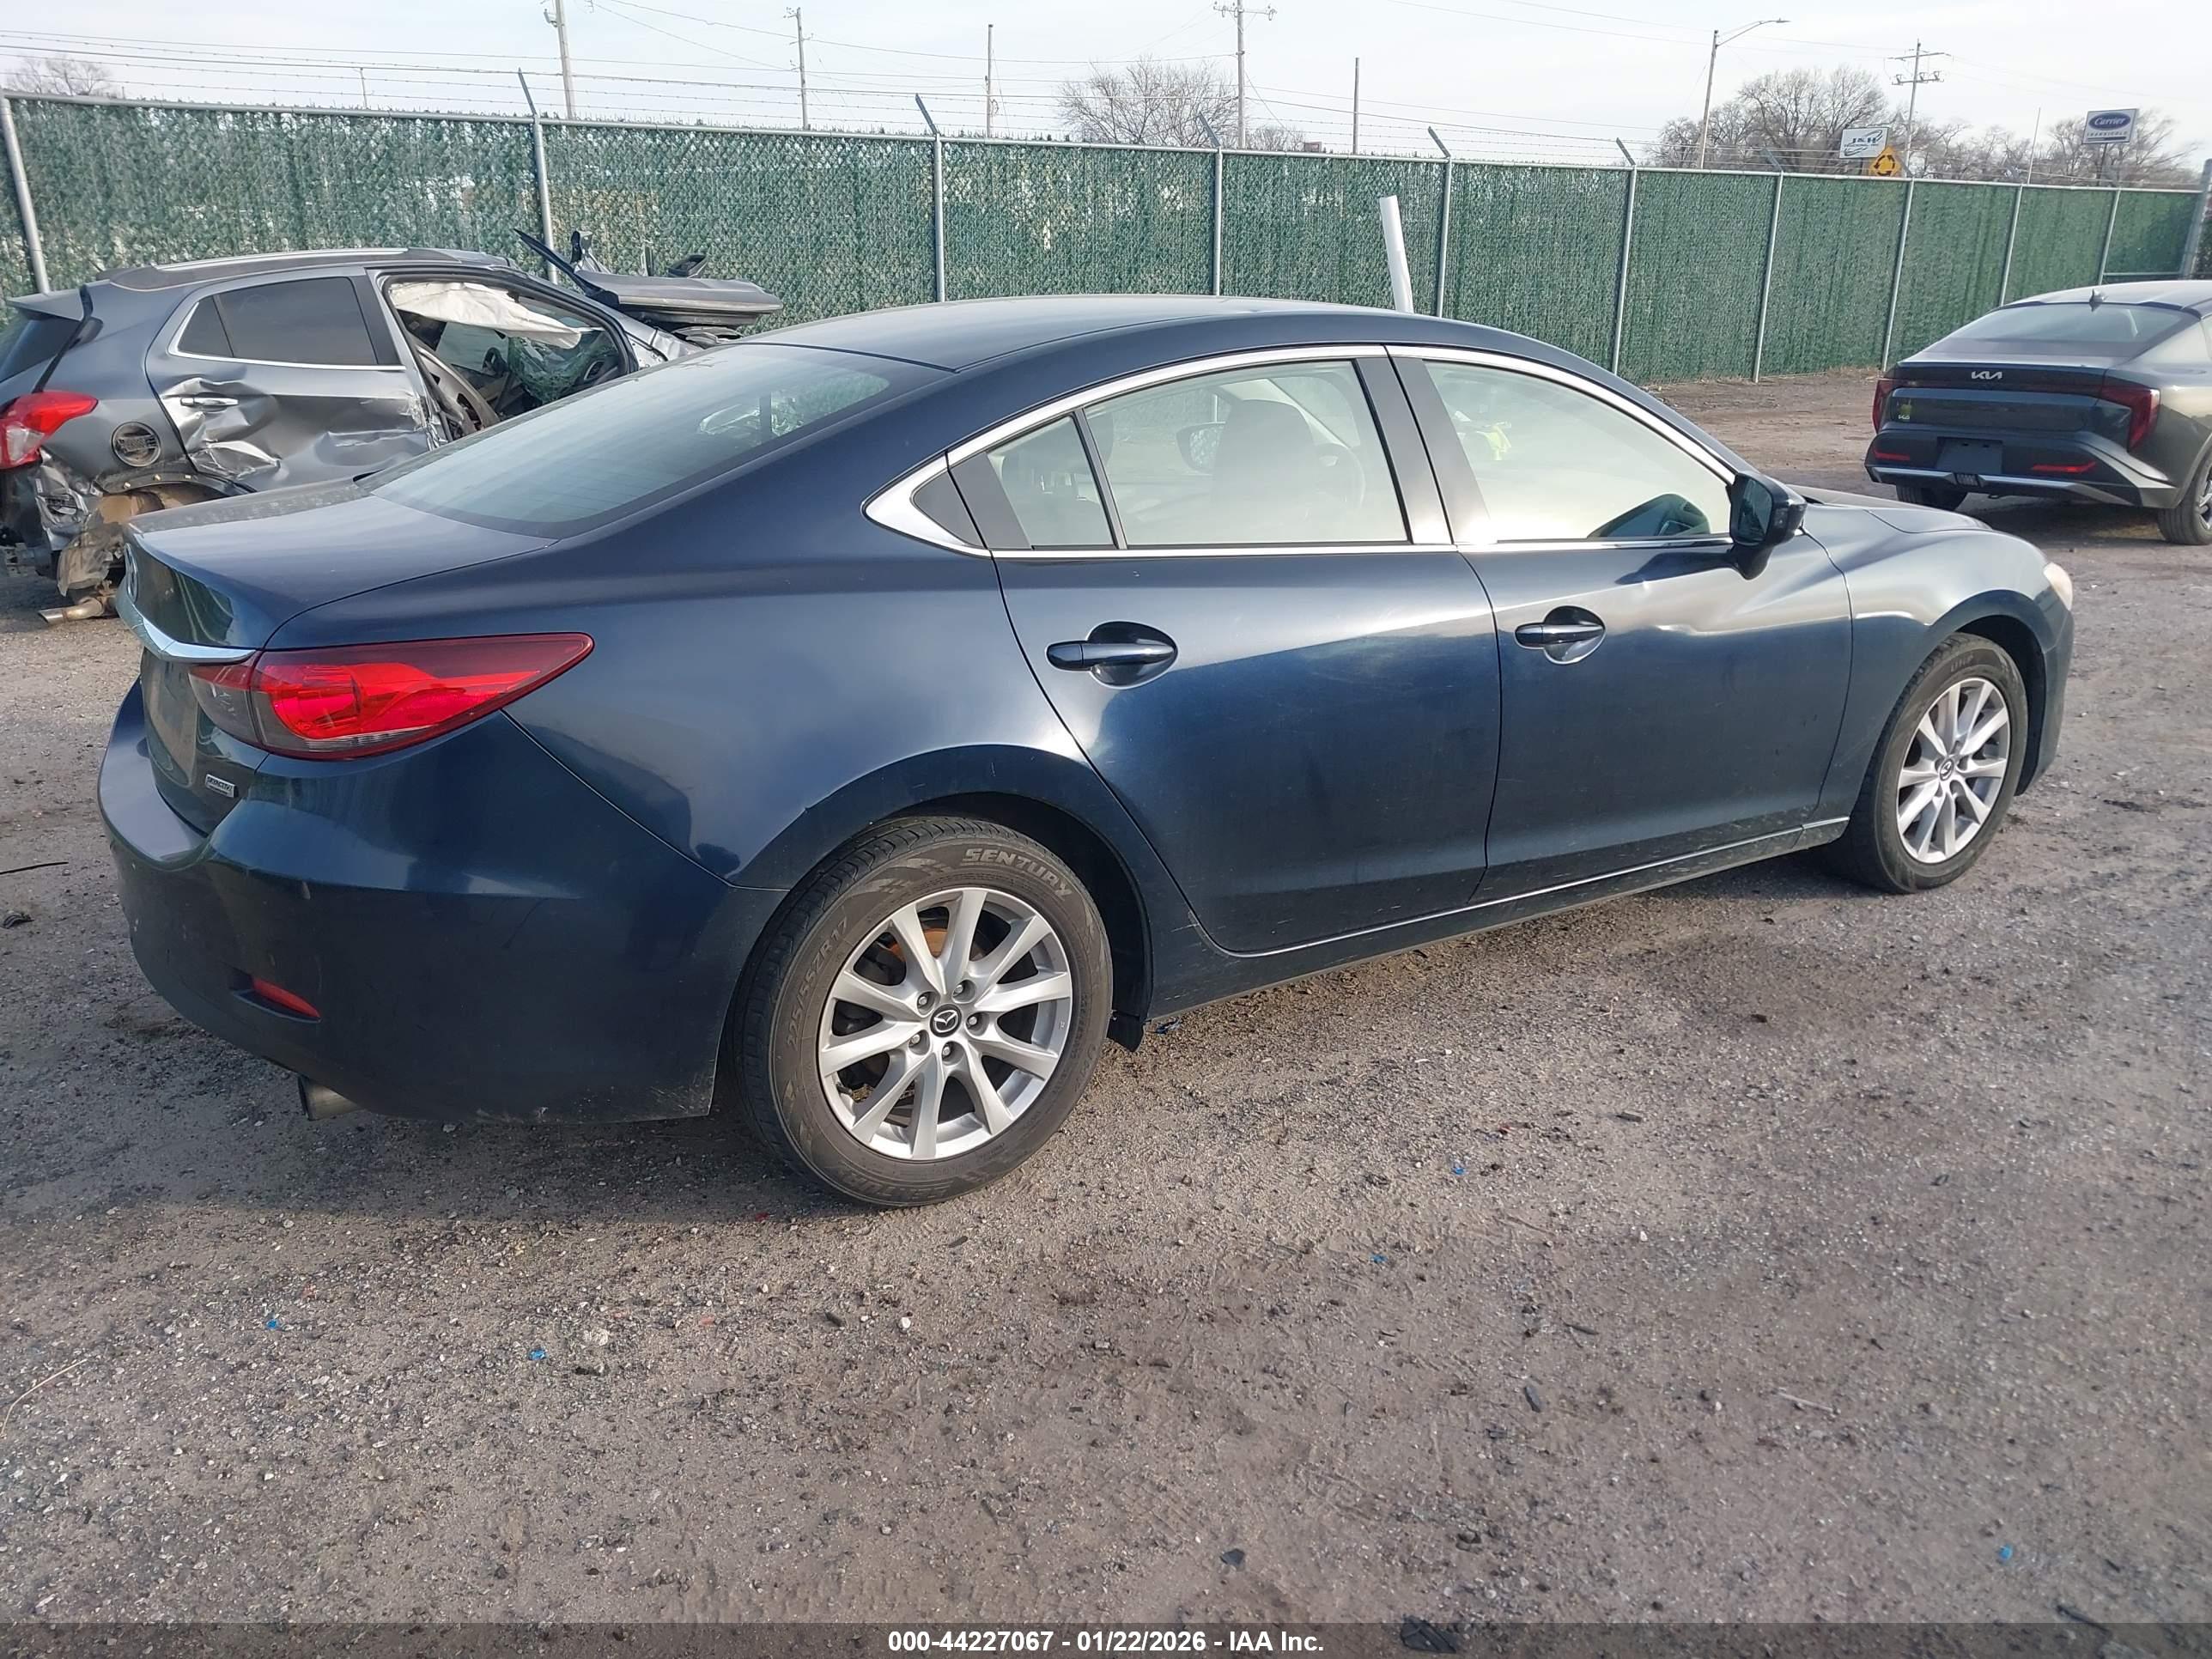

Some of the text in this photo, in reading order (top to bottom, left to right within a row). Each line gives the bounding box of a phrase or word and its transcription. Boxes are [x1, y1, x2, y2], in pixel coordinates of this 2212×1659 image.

[2094, 117, 2126, 125] Carrier
[1971, 371, 2002, 380] KIA
[962, 848, 1073, 899] SENTURY
